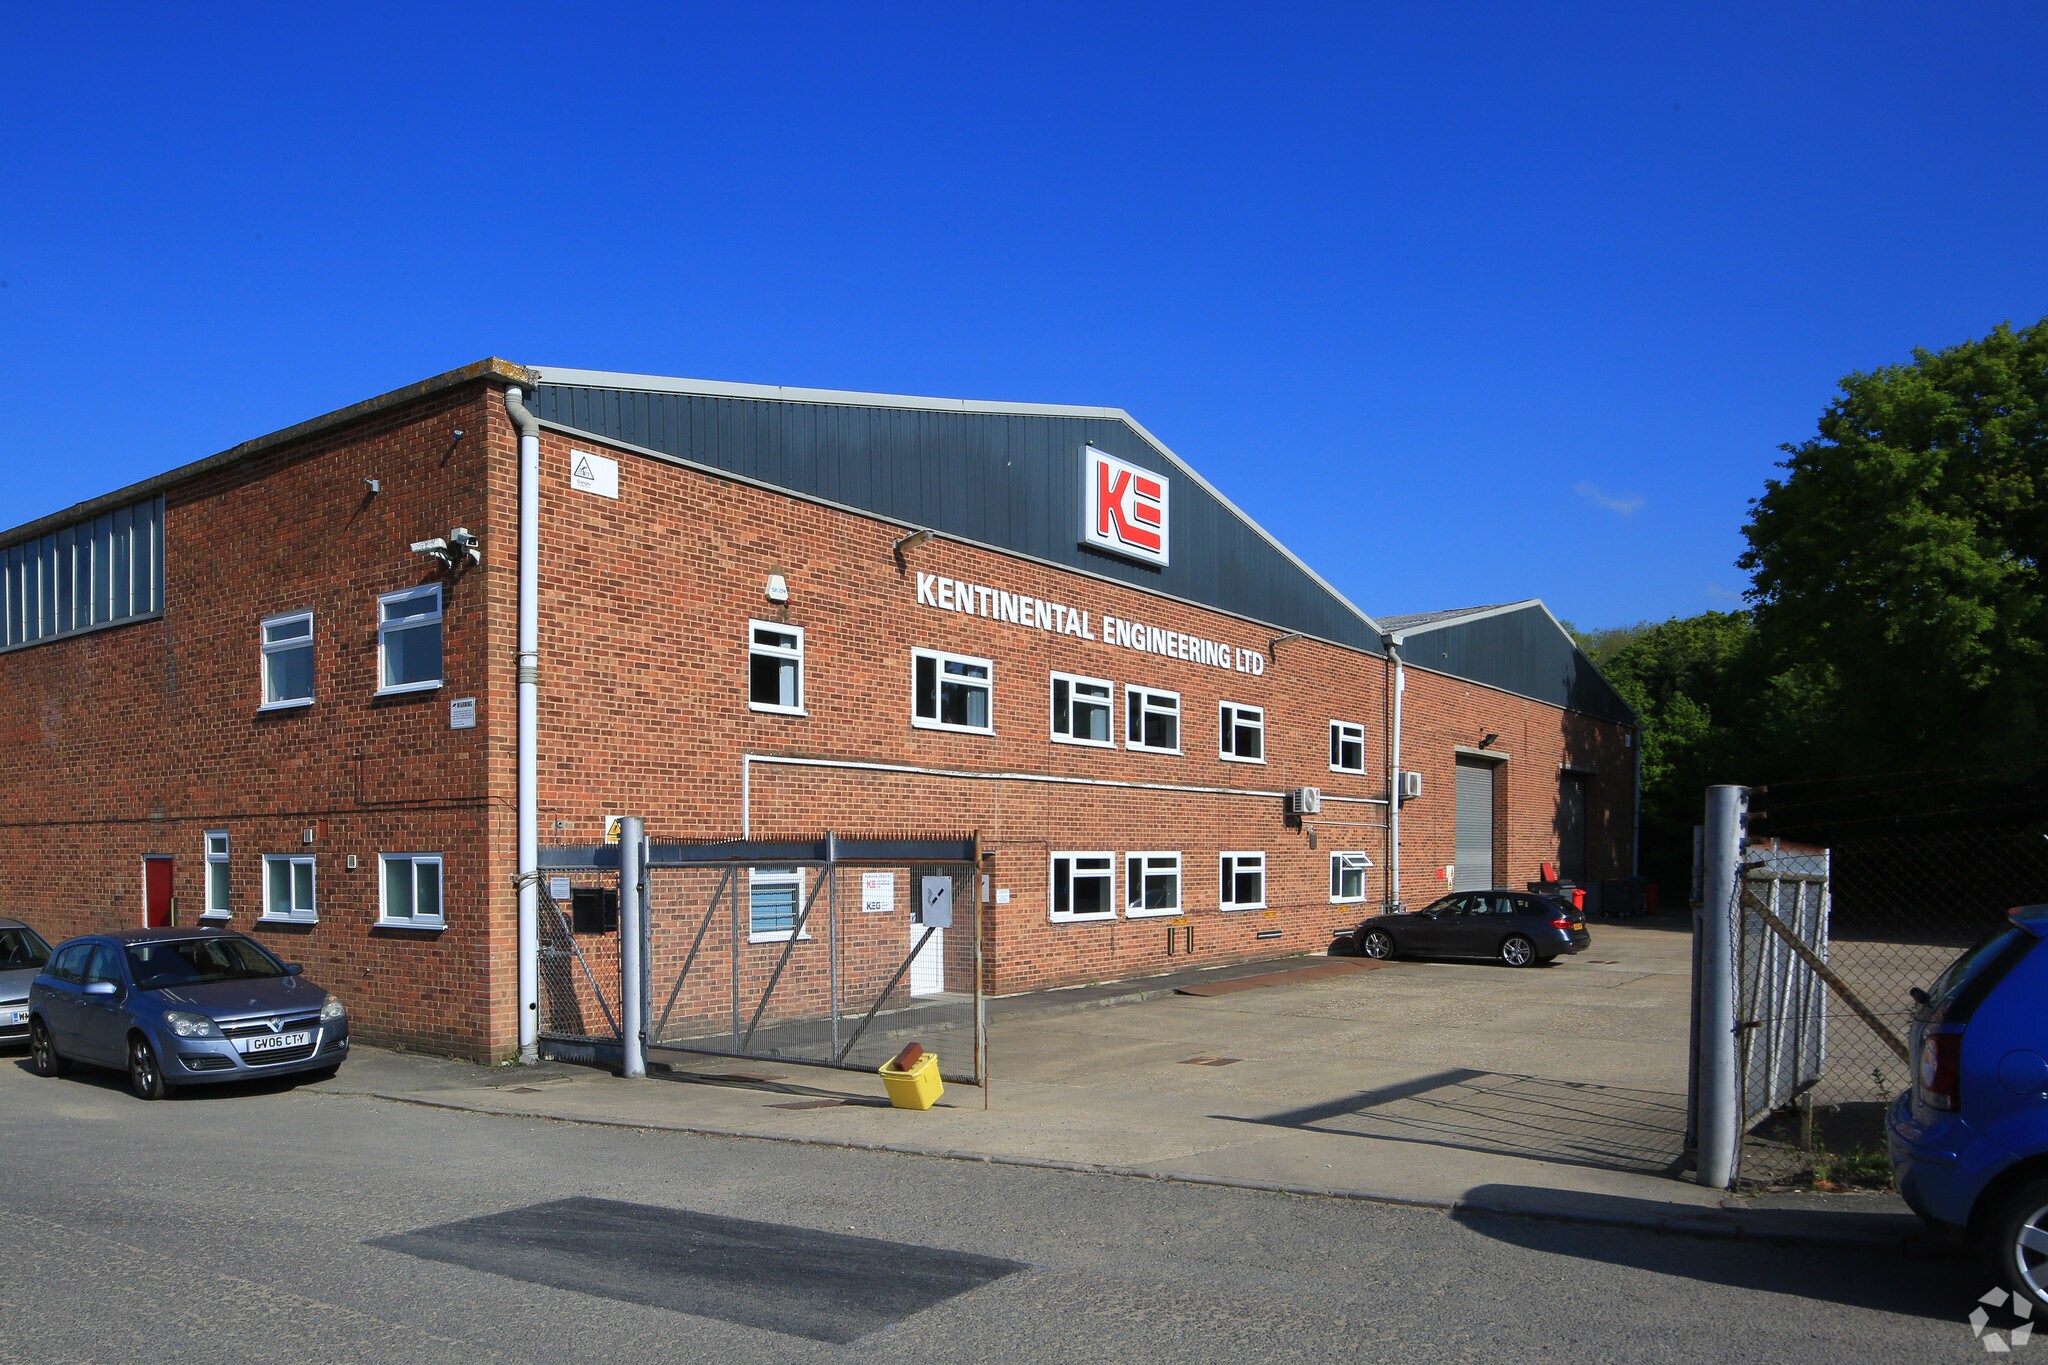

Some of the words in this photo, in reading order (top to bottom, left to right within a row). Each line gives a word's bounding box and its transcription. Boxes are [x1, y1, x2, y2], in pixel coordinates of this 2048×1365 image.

[1097, 460, 1160, 554] KE
[916, 572, 1094, 641] KENTINENTAL
[1103, 616, 1231, 669] ENGINEERING
[1235, 647, 1264, 676] LTD
[254, 1037, 283, 1049] GV06
[285, 1033, 304, 1045] CTY
